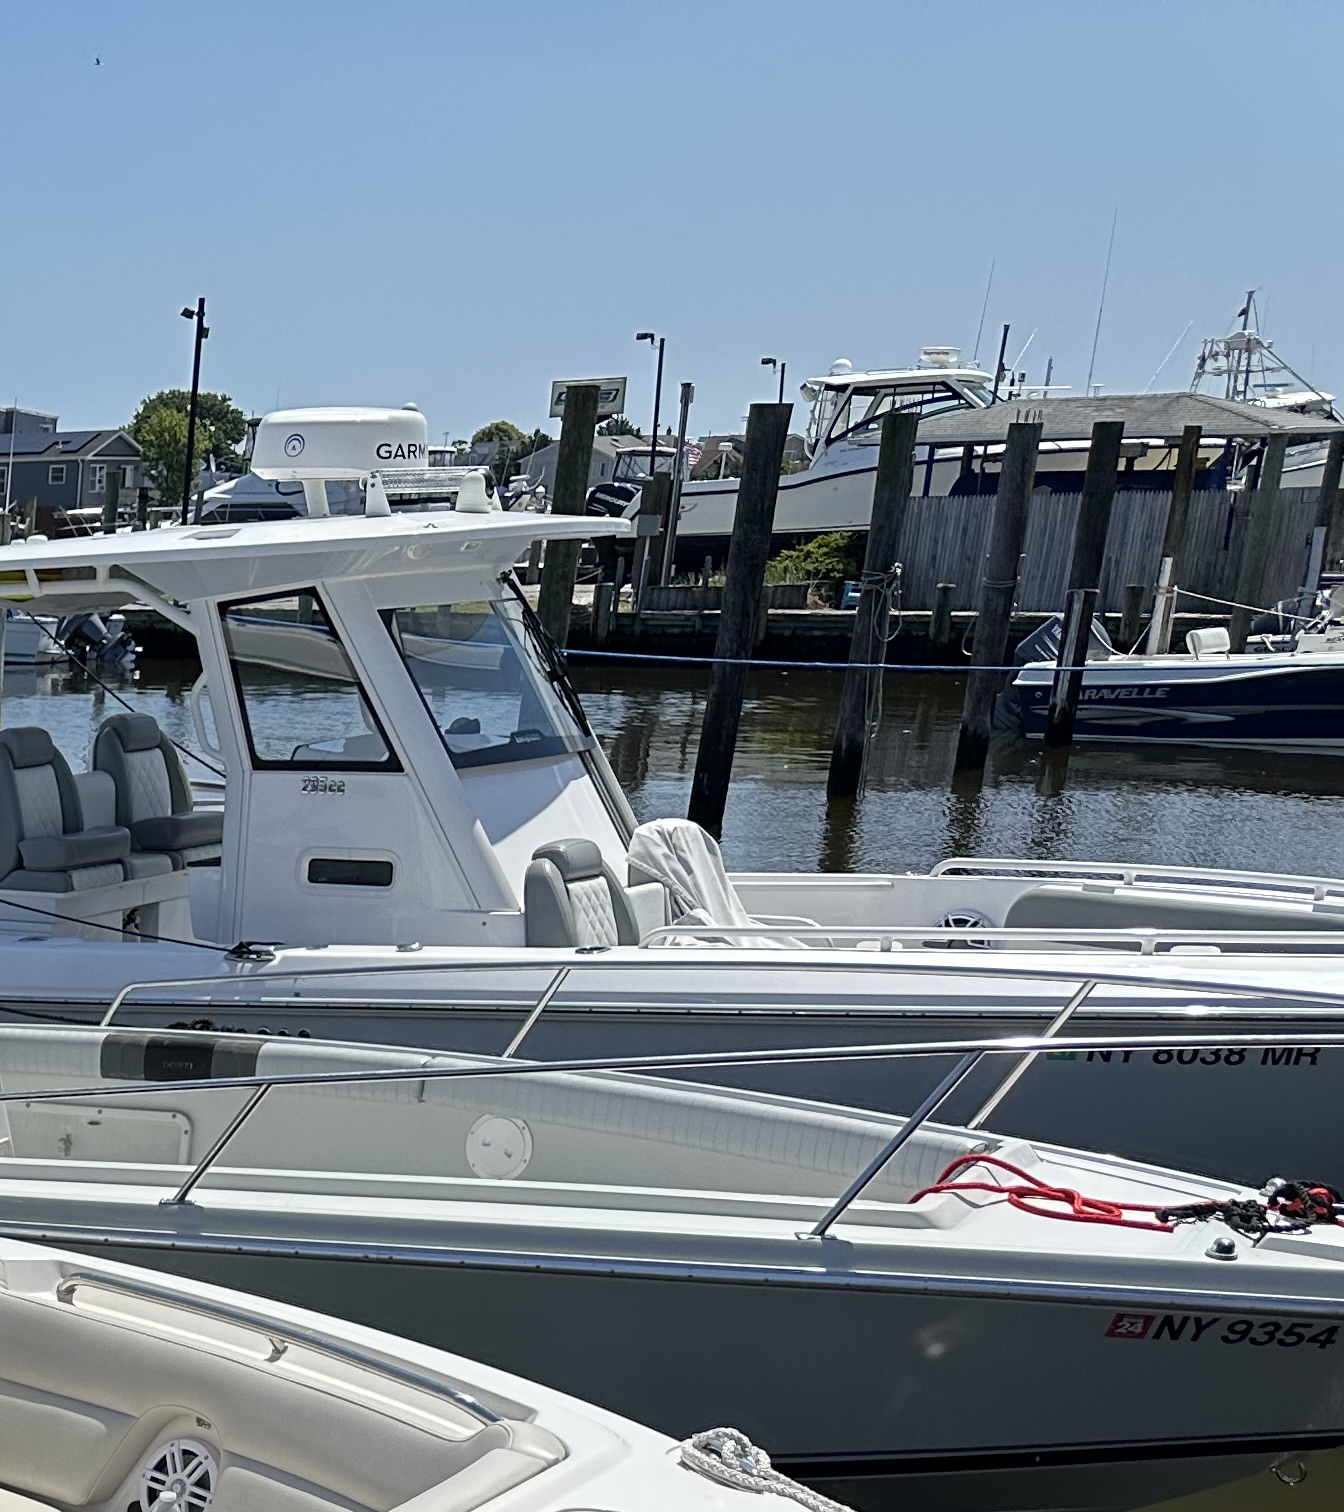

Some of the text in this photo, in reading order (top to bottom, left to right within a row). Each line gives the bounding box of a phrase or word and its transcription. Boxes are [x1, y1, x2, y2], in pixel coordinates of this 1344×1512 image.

[376, 443, 427, 460] GARM
[1078, 687, 1171, 701] RAVELLE
[1152, 1314, 1222, 1342] NY
[1220, 1319, 1342, 1350] 9354
